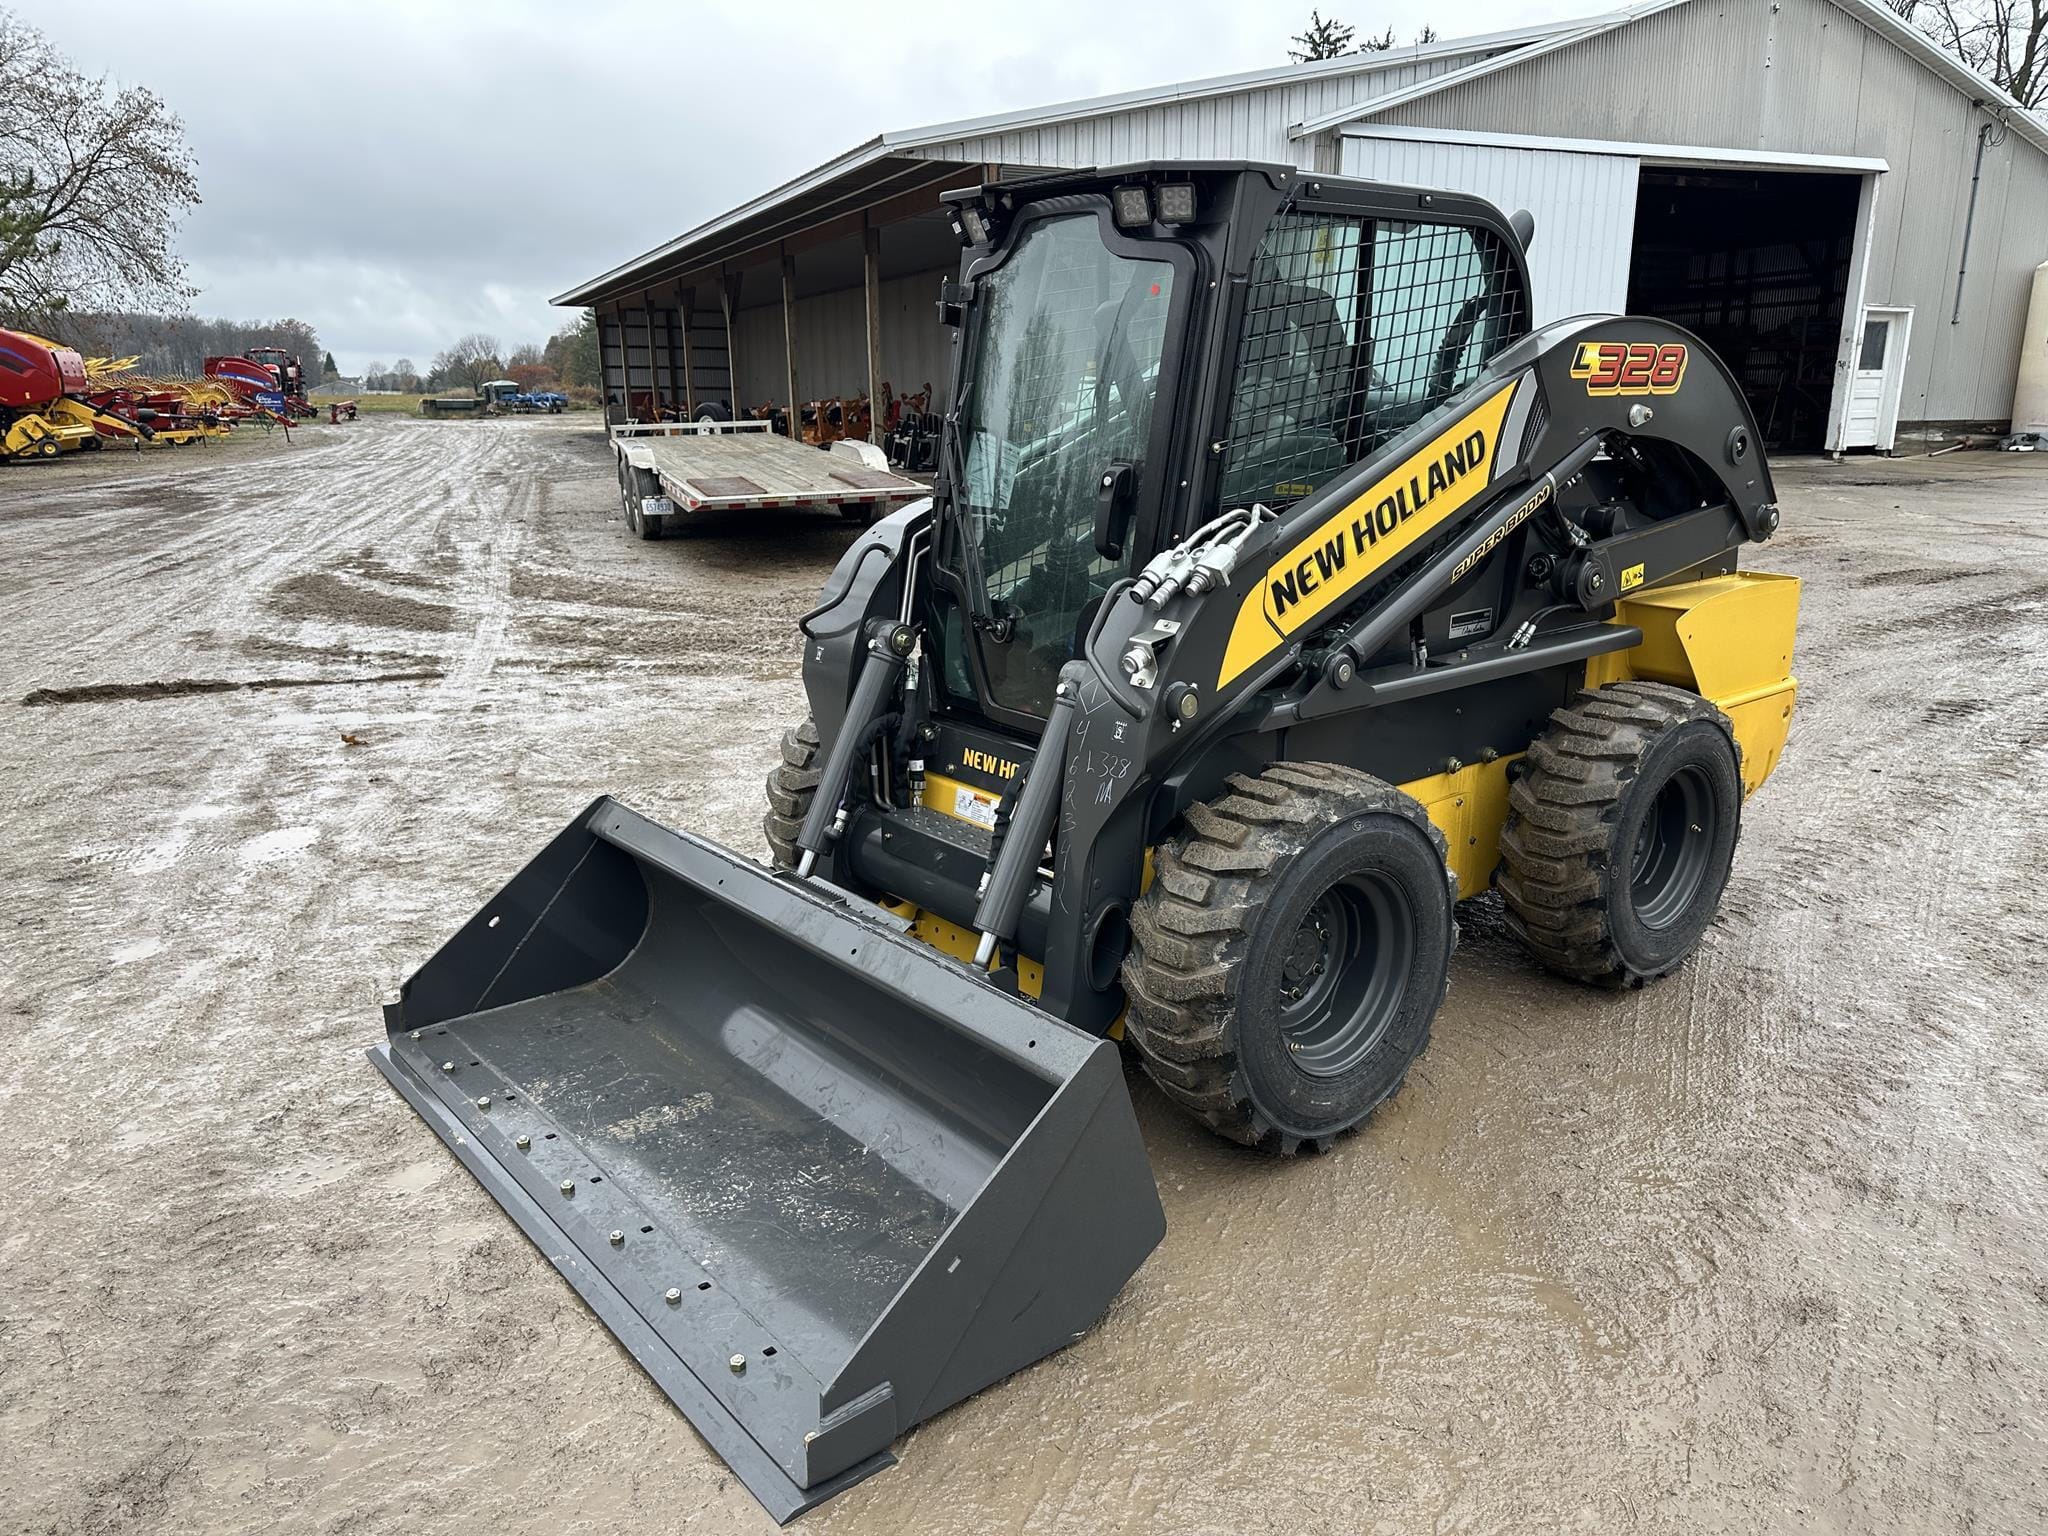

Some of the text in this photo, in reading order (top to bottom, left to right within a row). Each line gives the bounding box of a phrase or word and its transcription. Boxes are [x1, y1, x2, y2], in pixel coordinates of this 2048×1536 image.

[1570, 342, 1688, 396] L328
[1270, 429, 1486, 617] NEW HOLLAND
[1450, 485, 1550, 585] SUPER BOOM
[963, 747, 997, 775] NEW
